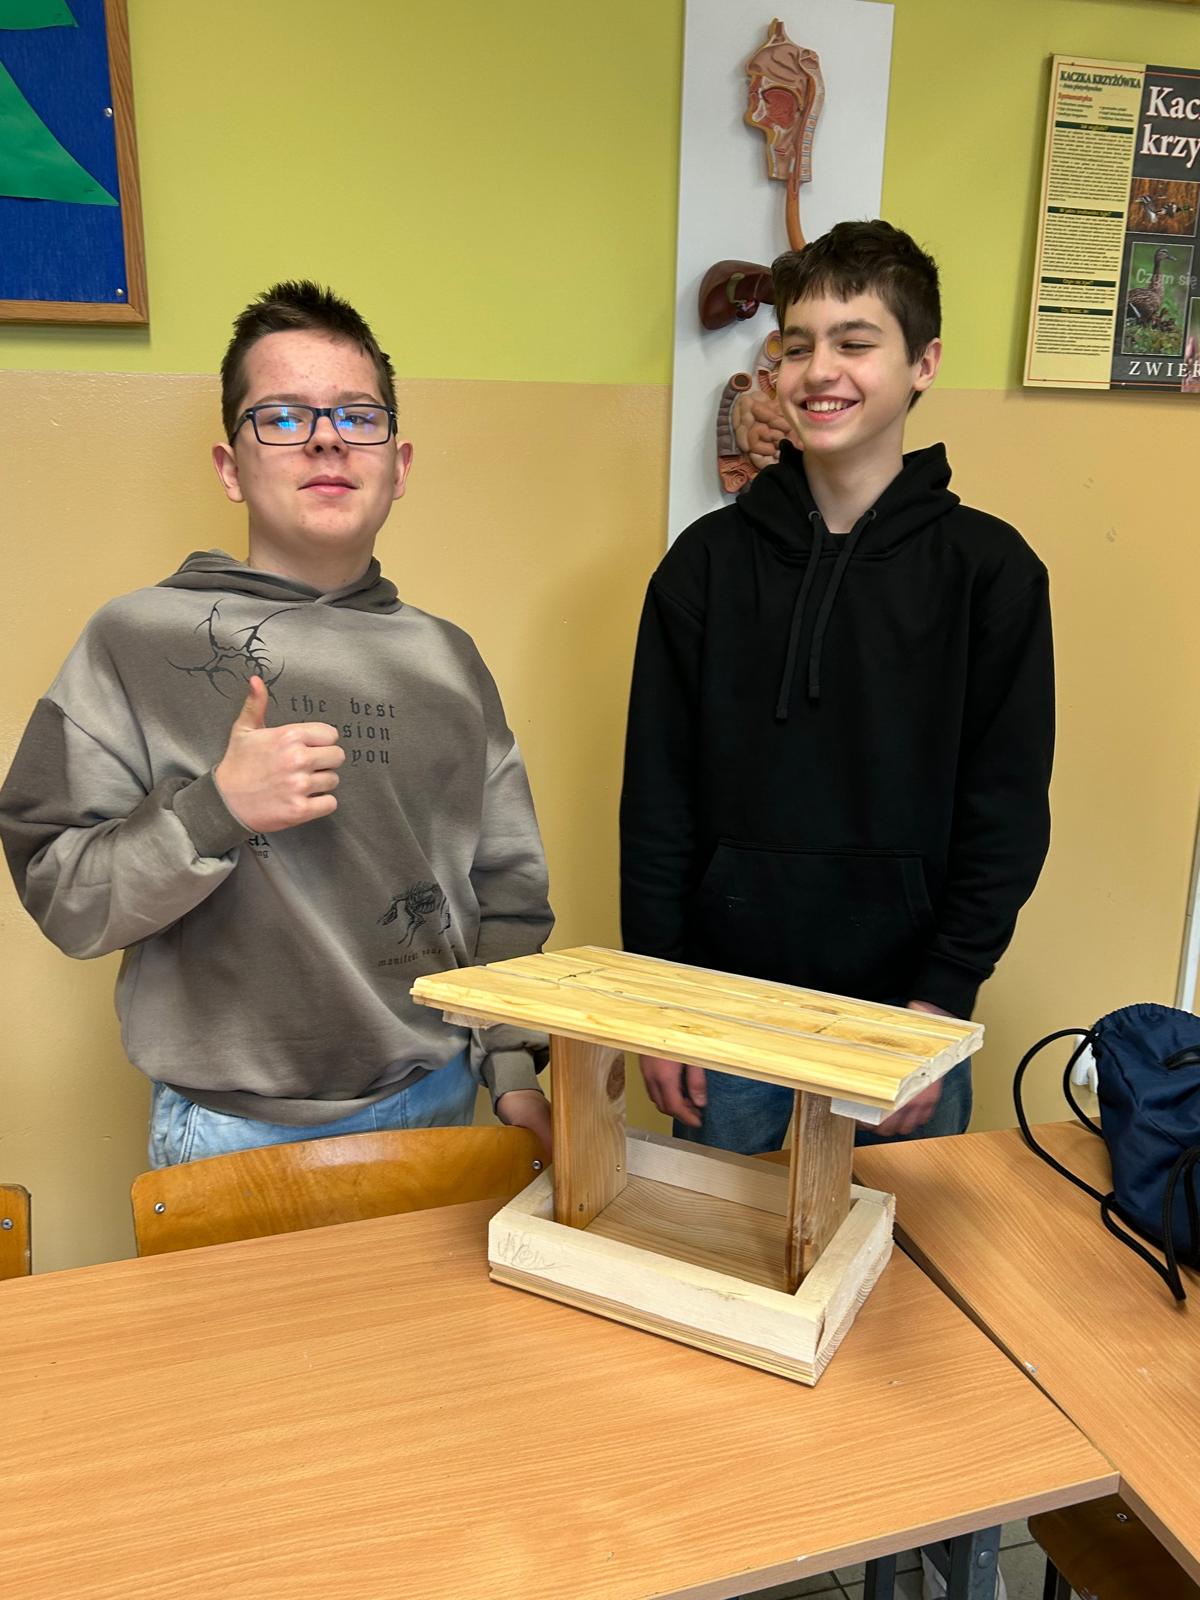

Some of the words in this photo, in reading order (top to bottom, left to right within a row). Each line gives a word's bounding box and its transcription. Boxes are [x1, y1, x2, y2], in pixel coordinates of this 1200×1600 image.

[1060, 70, 1092, 84] KACZKA
[1145, 86, 1200, 120] Kac
[290, 695, 327, 715] the
[350, 697, 395, 718] best
[331, 721, 390, 740] sion
[351, 749, 389, 766] you
